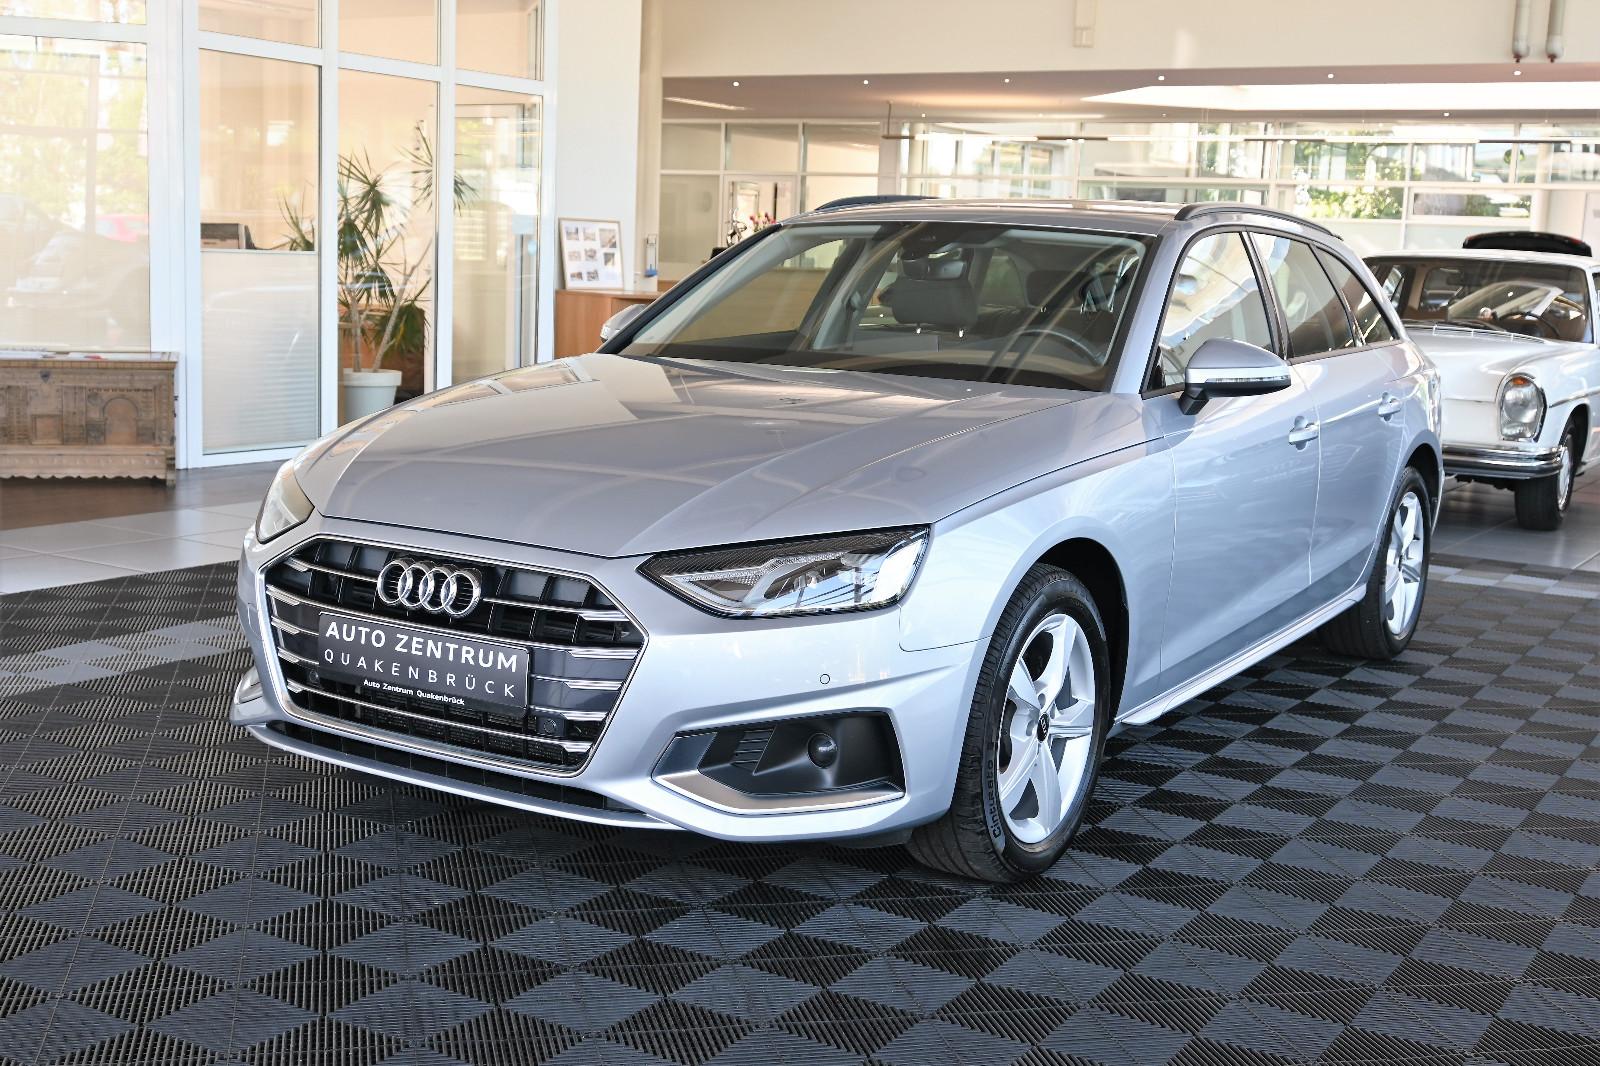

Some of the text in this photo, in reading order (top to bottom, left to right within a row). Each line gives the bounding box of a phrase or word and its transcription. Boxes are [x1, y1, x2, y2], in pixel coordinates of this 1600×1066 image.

[325, 621, 518, 673] AUTO ZENTRUM
[324, 649, 515, 698] QUAKENBRÜCK
[363, 679, 465, 706] Auto Zentrum Quakenbrück
[987, 760, 1001, 838] Cinturato
